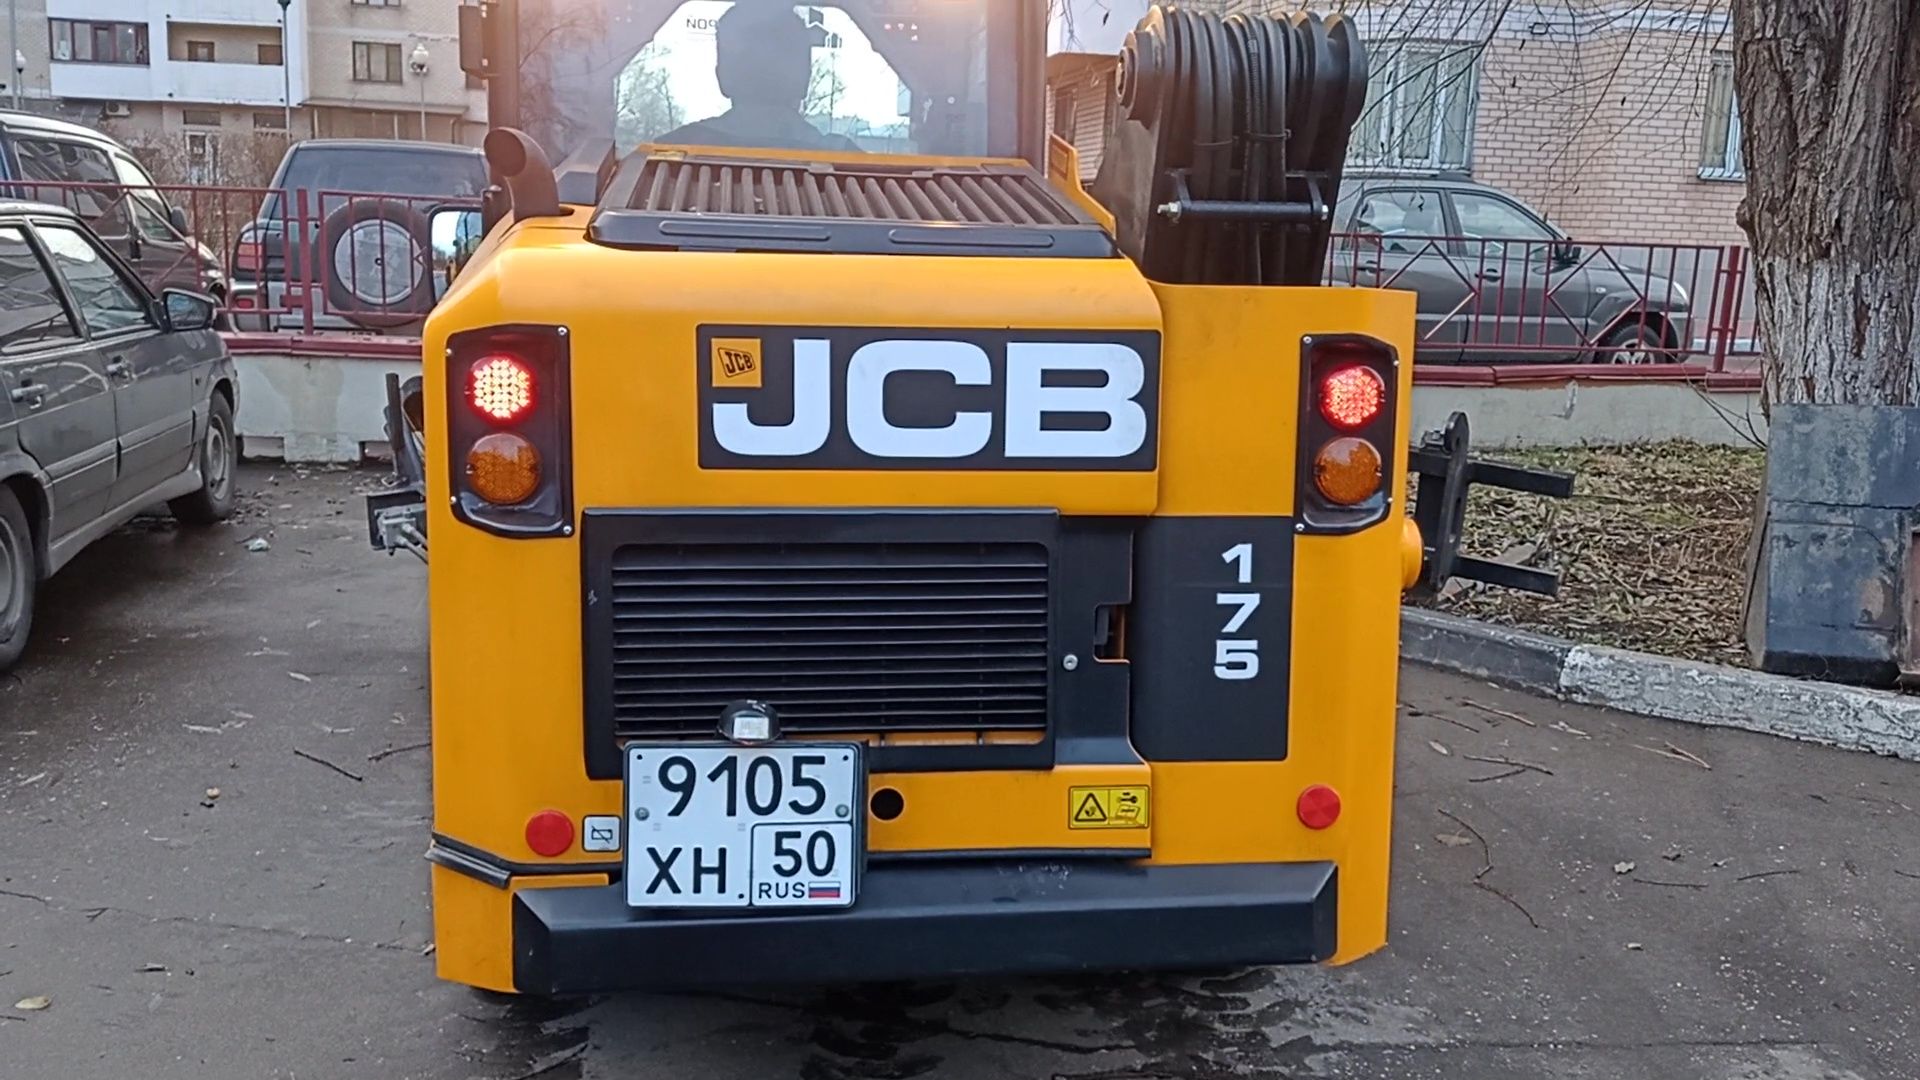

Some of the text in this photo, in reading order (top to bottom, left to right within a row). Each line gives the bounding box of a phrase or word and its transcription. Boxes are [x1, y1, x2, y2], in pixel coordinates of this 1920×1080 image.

[724, 351, 753, 374] JCB
[712, 338, 1147, 458] JCB
[658, 755, 827, 817] 9105
[772, 830, 836, 877] 50
[758, 881, 806, 899] RUS
